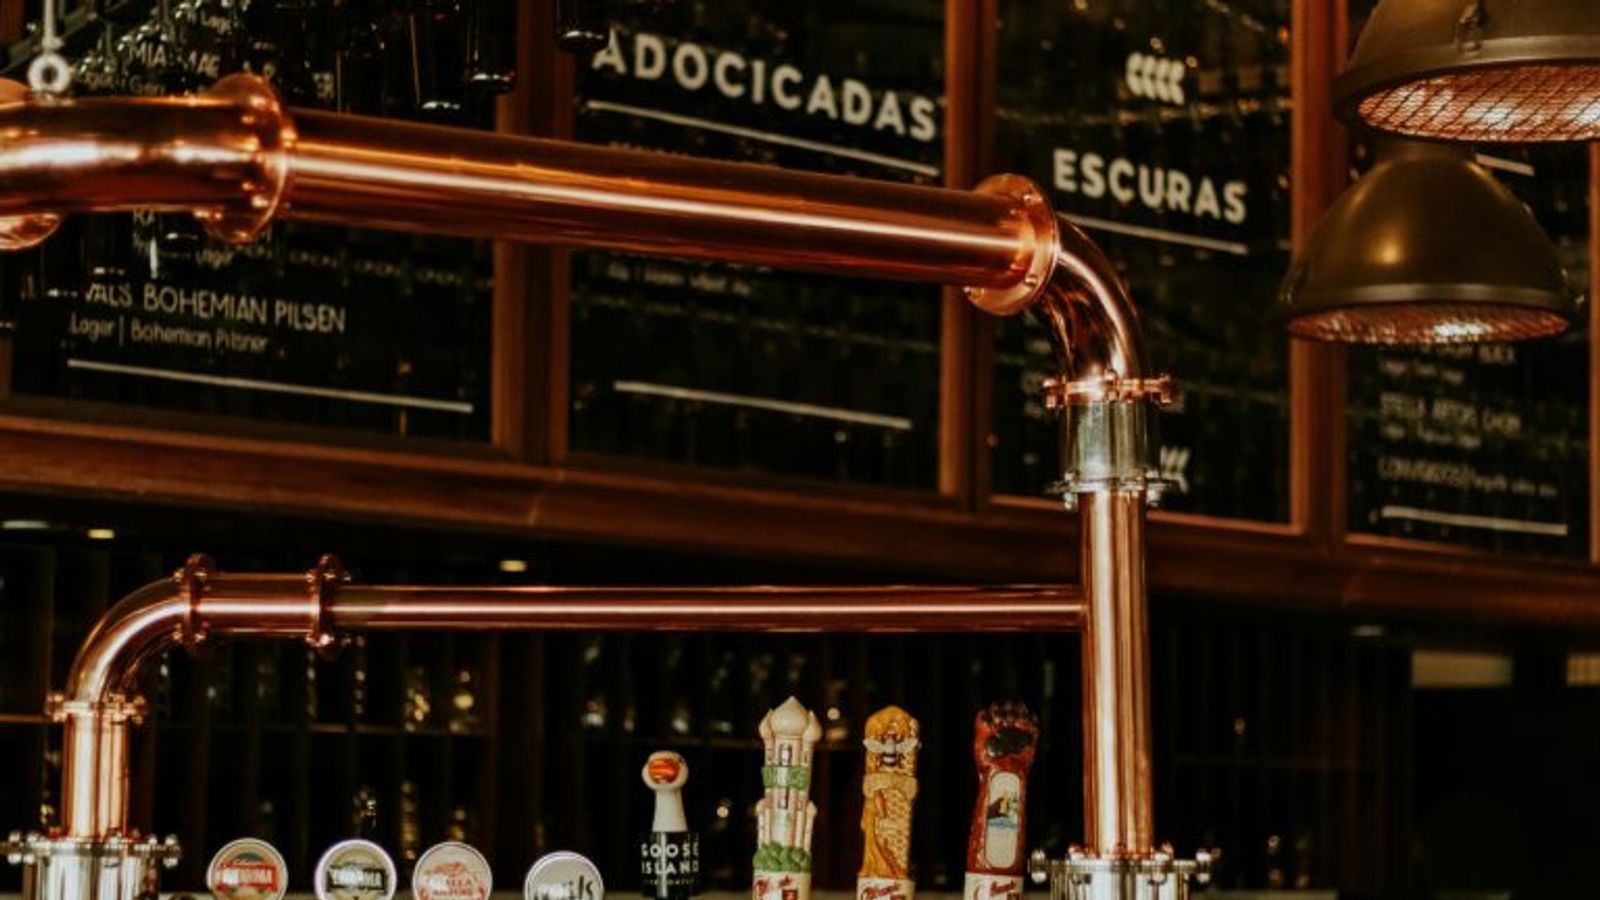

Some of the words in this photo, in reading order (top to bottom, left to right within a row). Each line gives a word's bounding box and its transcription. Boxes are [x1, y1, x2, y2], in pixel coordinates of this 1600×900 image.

[592, 26, 936, 141] ADOCICADAS
[1053, 149, 1248, 223] ESCURAS
[70, 313, 116, 340] Lager
[143, 283, 268, 324] BOHEMIAN
[274, 300, 346, 334] PILSEN
